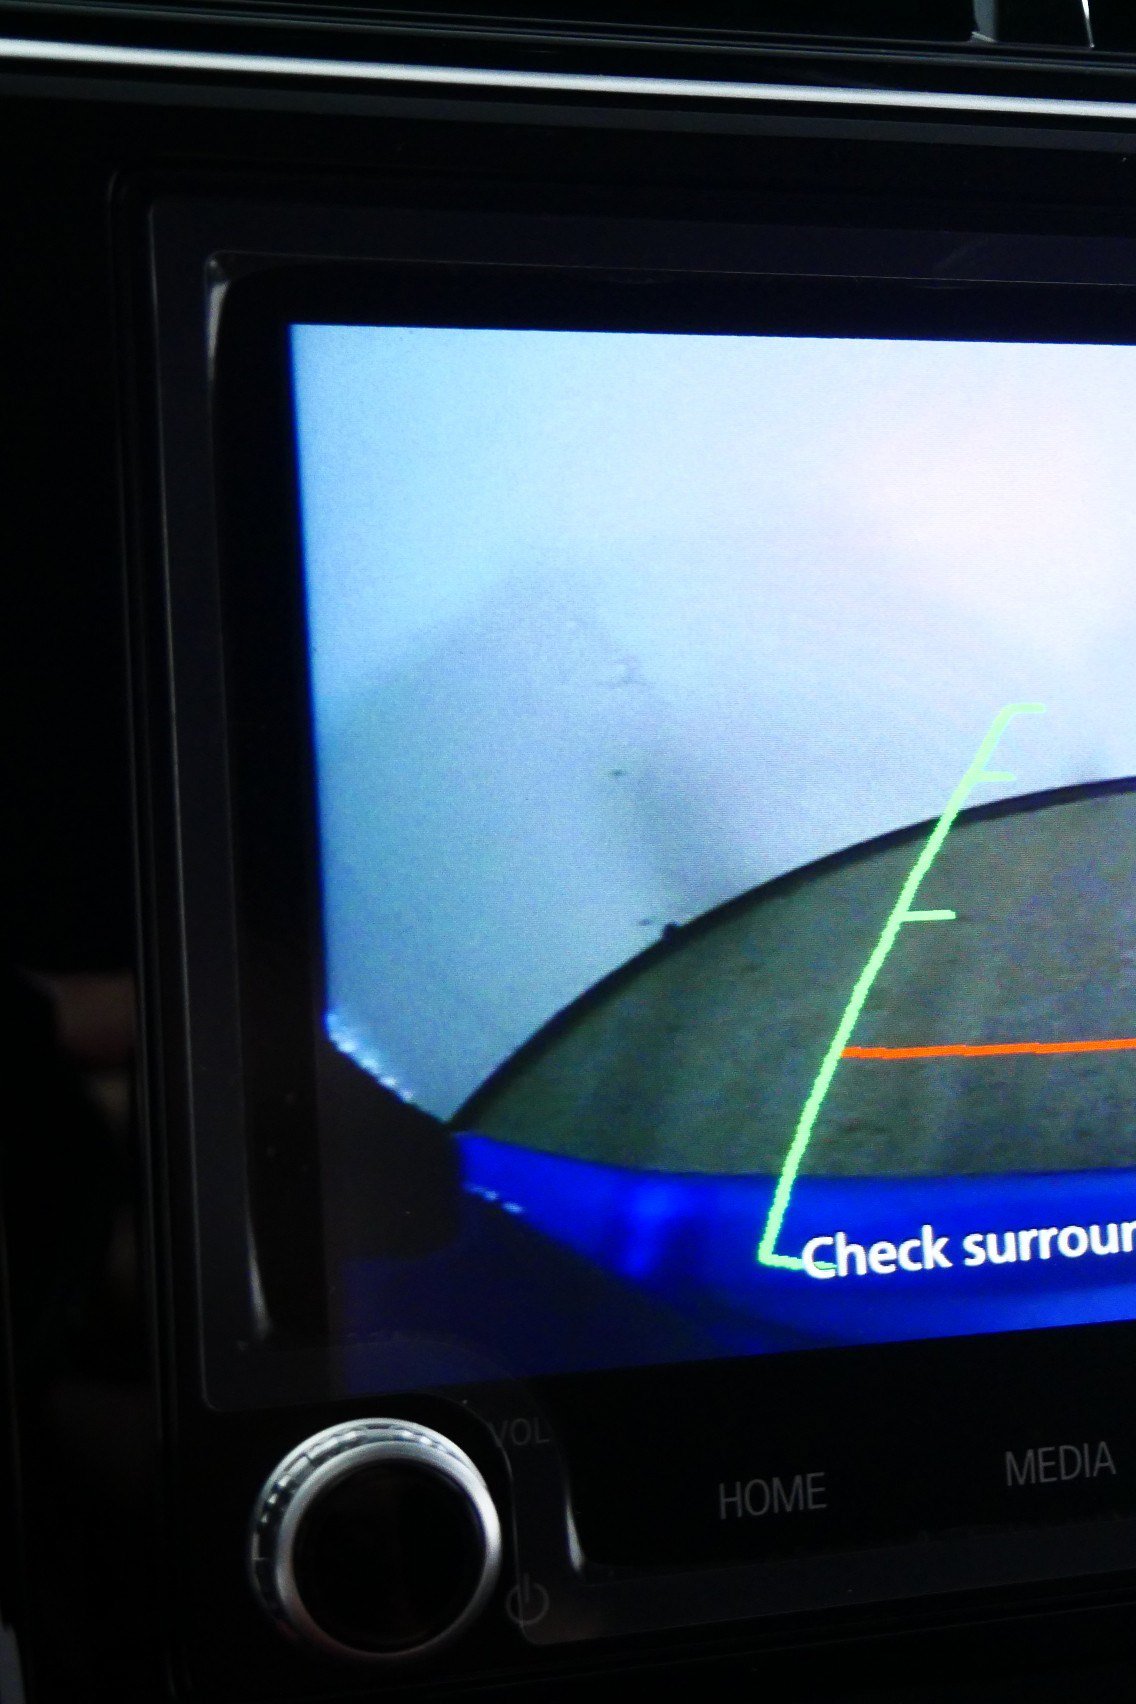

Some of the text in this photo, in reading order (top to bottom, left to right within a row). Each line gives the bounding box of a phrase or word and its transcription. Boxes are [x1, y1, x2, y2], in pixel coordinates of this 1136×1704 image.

[802, 1226, 950, 1280] Check
[490, 1417, 551, 1448] VOL
[1004, 1441, 1116, 1488] MEDIA
[717, 1473, 828, 1520] HOME
